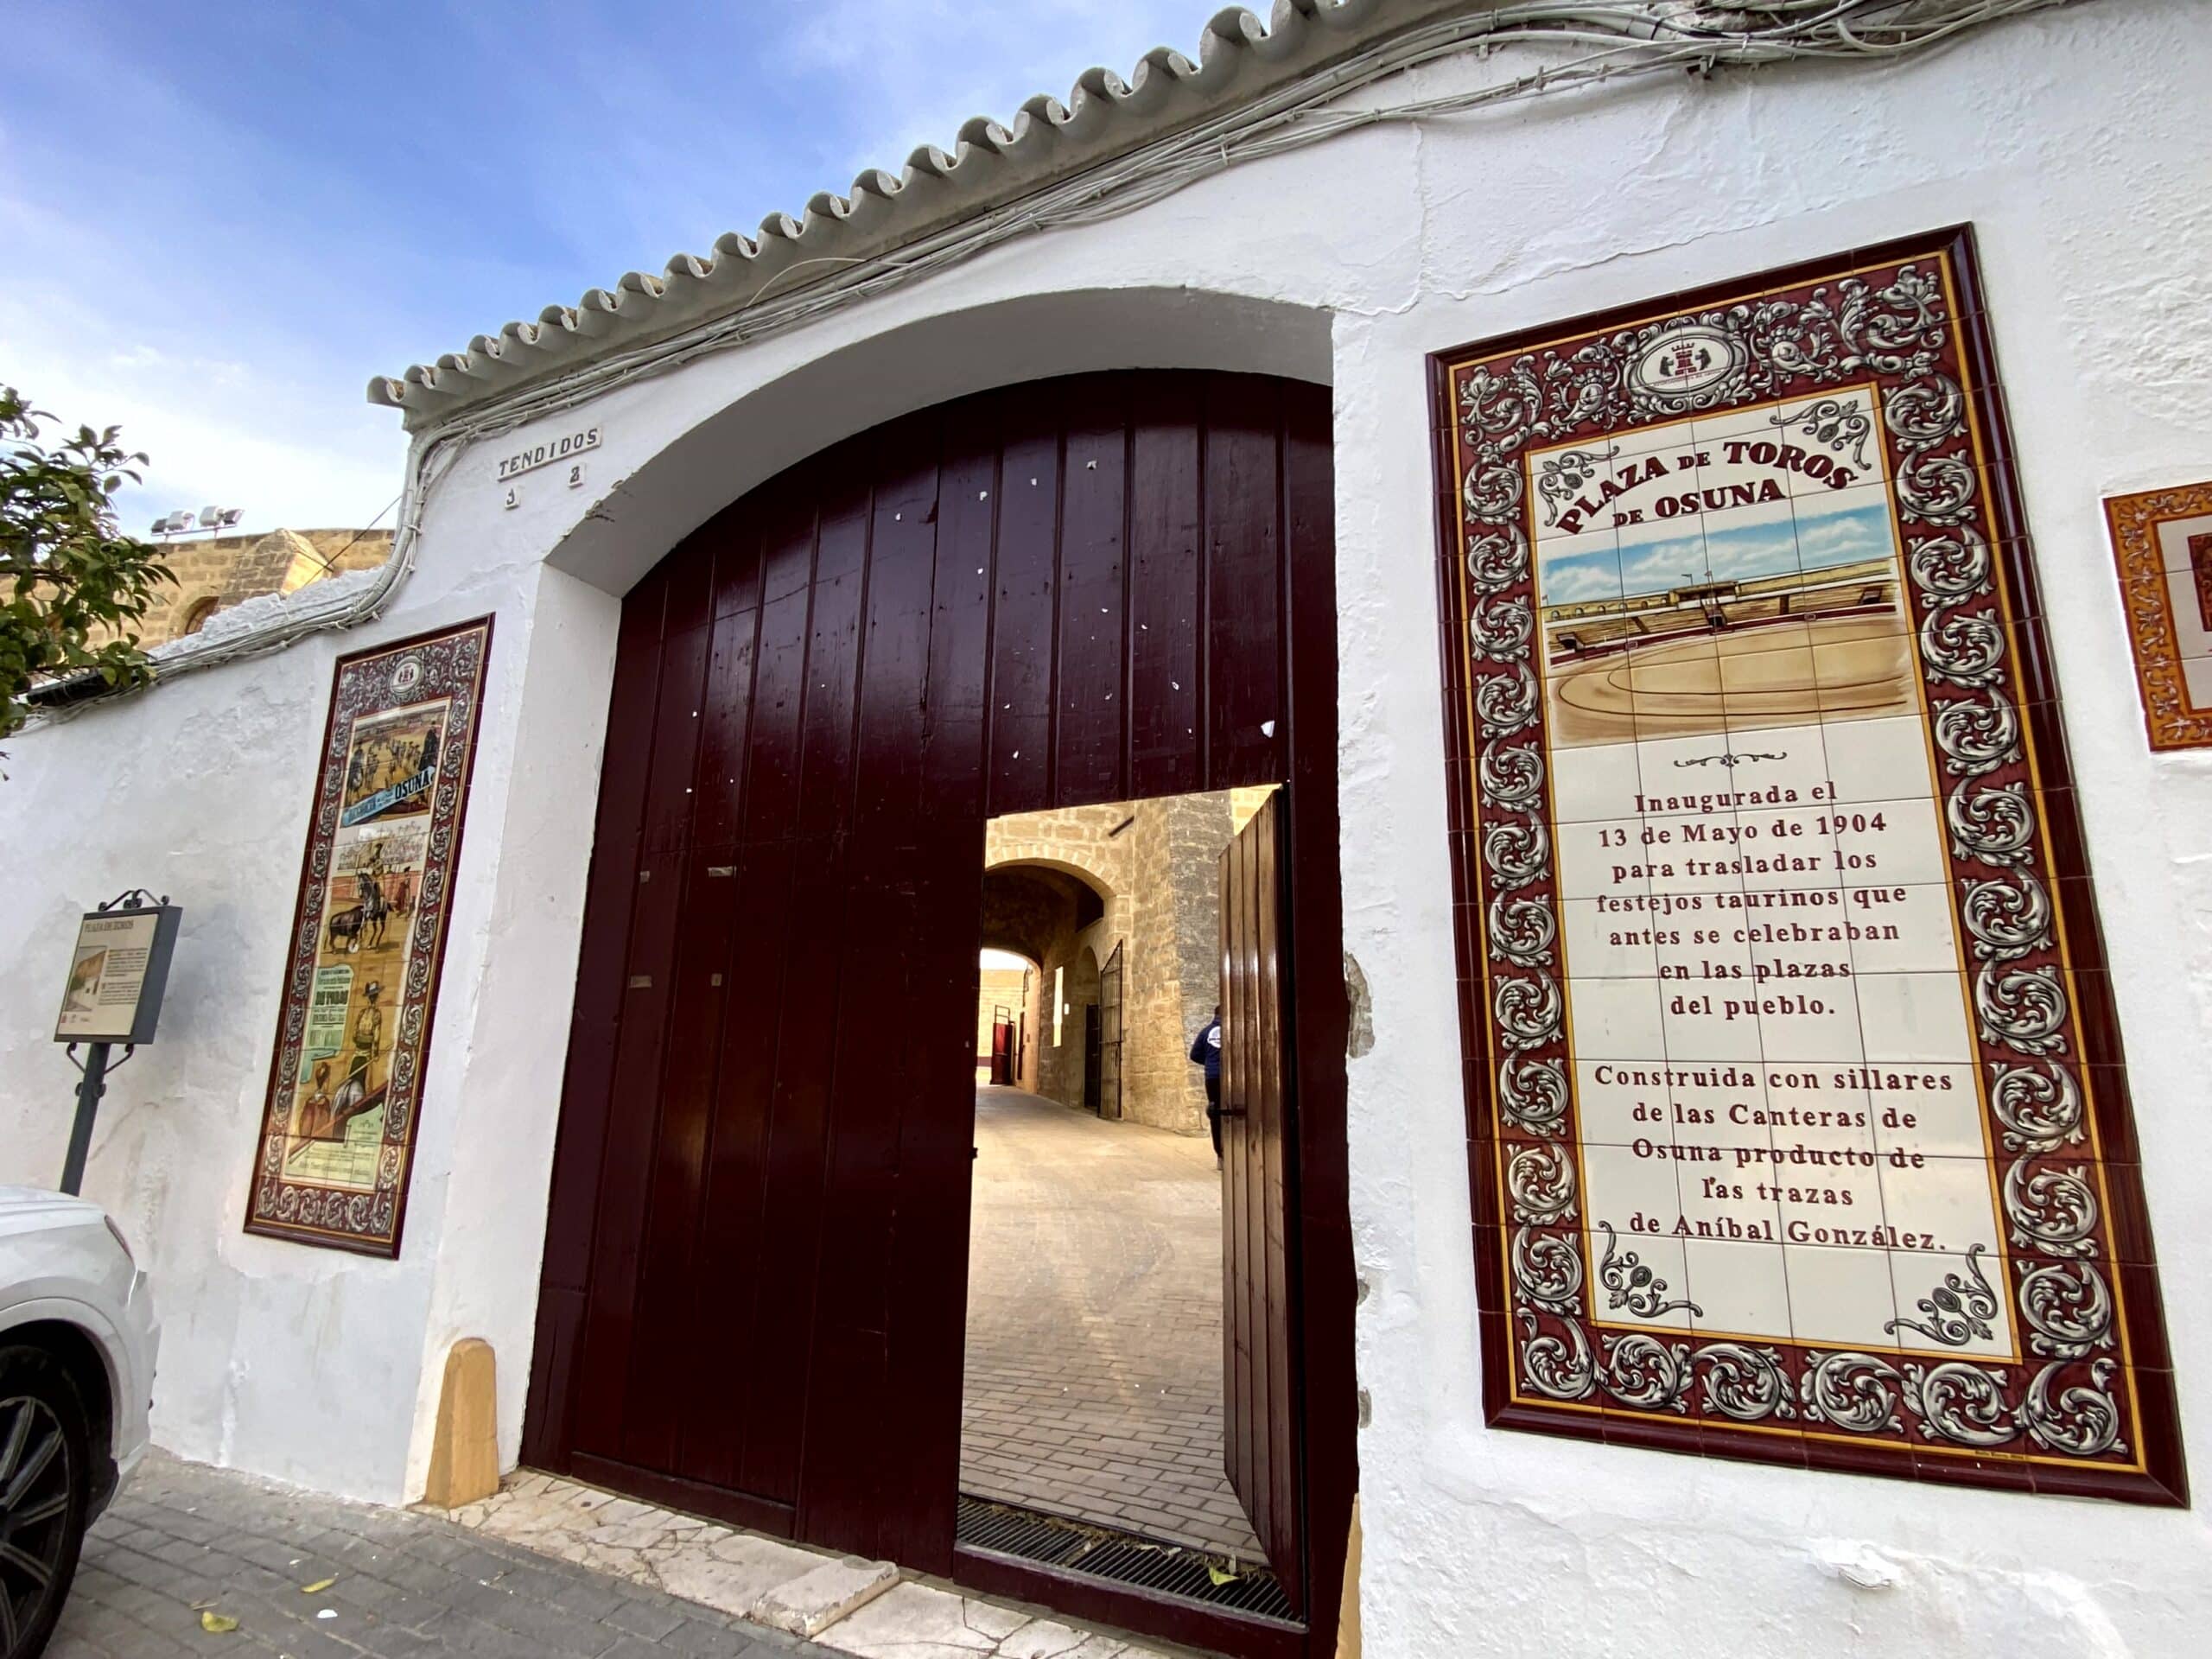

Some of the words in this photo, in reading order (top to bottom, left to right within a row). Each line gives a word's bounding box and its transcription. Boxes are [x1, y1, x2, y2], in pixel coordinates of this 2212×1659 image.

[499, 428, 598, 476] TENDIDOS
[1556, 456, 1669, 534] PLAZA
[1678, 452, 1711, 470] DE
[1723, 442, 1859, 489] TOROS
[1613, 510, 1643, 526] DE
[1655, 479, 1785, 518] OSUNA
[395, 770, 429, 799] OSUNA
[1634, 785, 1798, 813] Inaugurada
[1812, 782, 1837, 799] el
[1599, 830, 1627, 847] 13
[1641, 828, 1671, 845] de
[1682, 824, 1758, 844] Mayo
[1771, 819, 1802, 836] de
[1816, 813, 1886, 835] 1904
[1612, 861, 1675, 883] para
[1686, 854, 1821, 876] trasladar
[1834, 850, 1876, 869] los
[1597, 894, 1702, 915] festejos
[1716, 889, 1839, 908] taurinos
[1853, 887, 1906, 908] que
[1610, 927, 1680, 945] antes
[1694, 928, 1720, 943] se
[1734, 922, 1900, 942] celebraban
[1661, 965, 1688, 980] en
[1703, 961, 1742, 978] las
[1755, 959, 1851, 983] plazas
[1671, 996, 1712, 1014] del
[1725, 995, 1835, 1020] pueblo.
[1595, 1065, 1756, 1088] Construida
[1769, 1074, 1820, 1090] con
[1834, 1069, 1952, 1090] sillares
[1632, 1103, 1662, 1122] de
[1675, 1104, 1714, 1123] las
[1729, 1104, 1866, 1127] Canteras
[1882, 1109, 1916, 1128] de
[1632, 1139, 1722, 1161] Osuna
[1736, 1144, 1874, 1168] producto
[1890, 1148, 1924, 1168] de
[1702, 1177, 1743, 1199] las
[1758, 1184, 1853, 1205] trazas
[1630, 1213, 1660, 1232] de
[1673, 1215, 1773, 1241] Aníbal
[1788, 1221, 1946, 1251] González.
